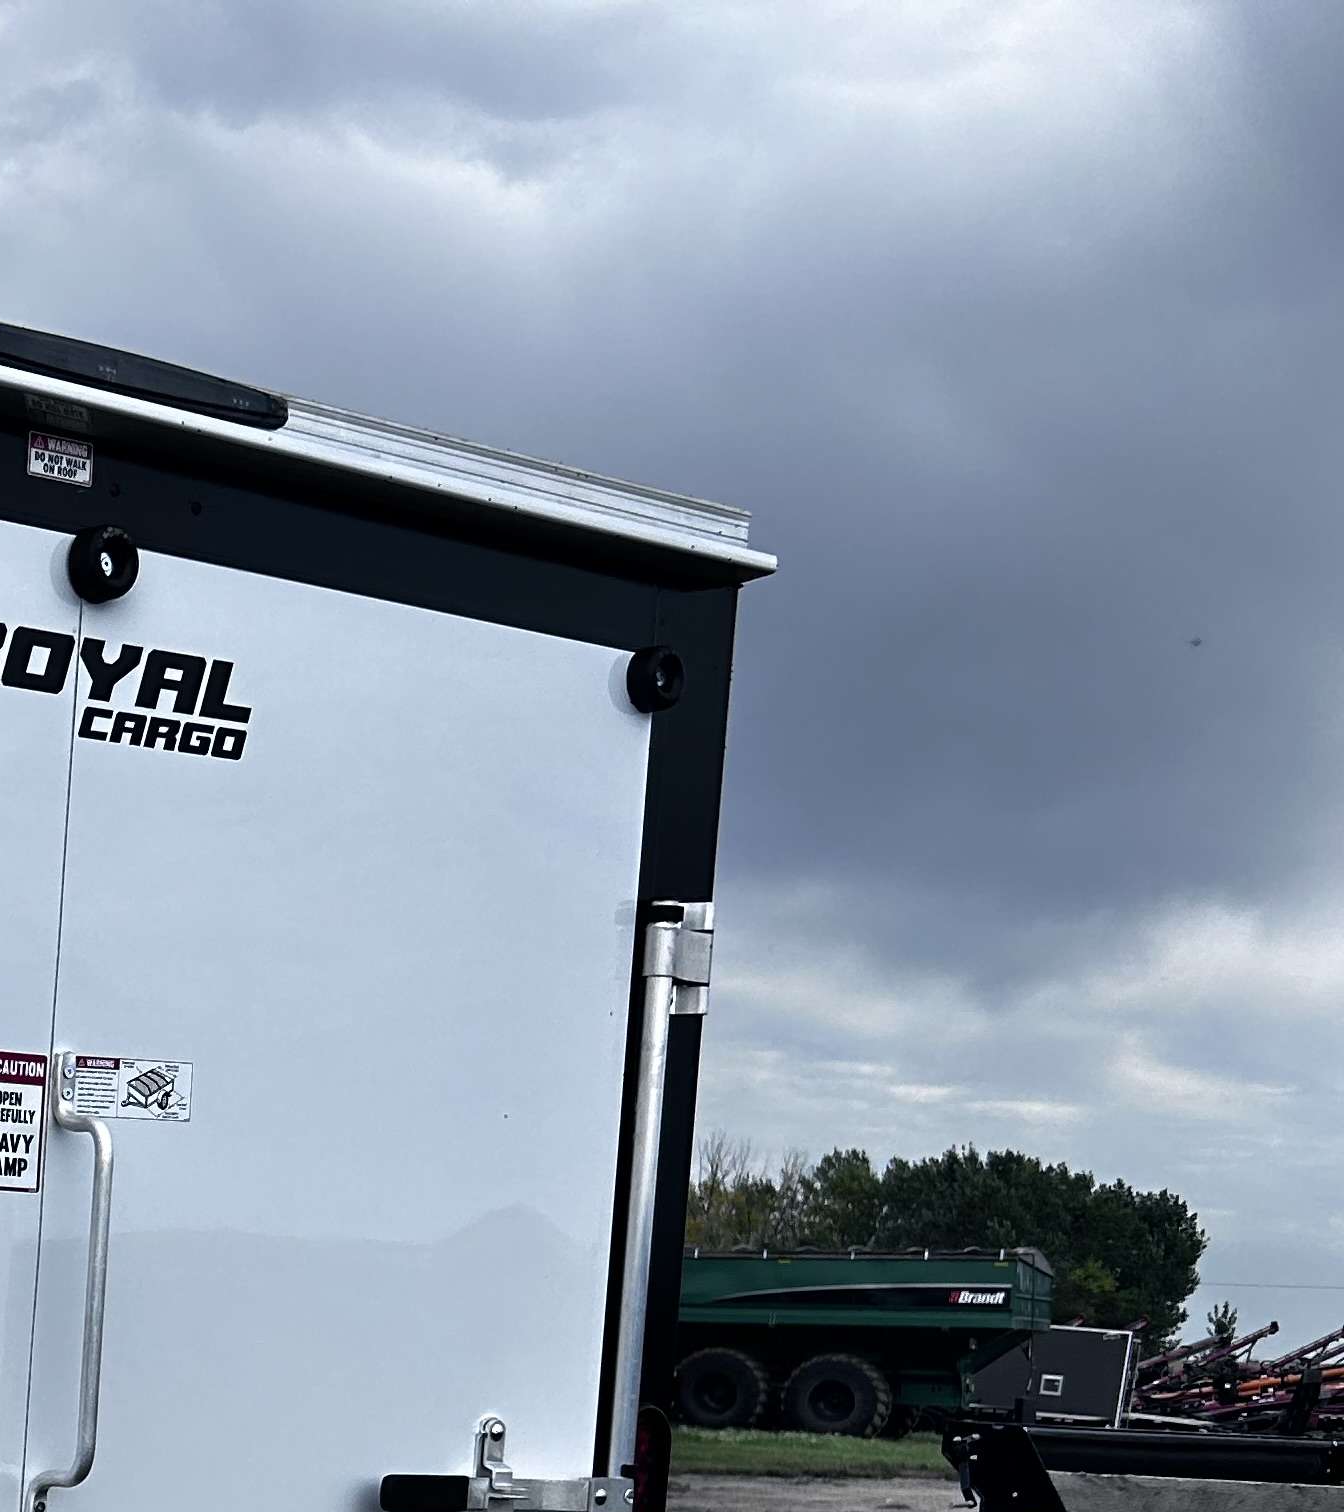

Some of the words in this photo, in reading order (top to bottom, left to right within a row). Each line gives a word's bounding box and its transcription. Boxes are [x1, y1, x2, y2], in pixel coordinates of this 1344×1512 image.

[34, 450, 46, 462] DO
[47, 453, 64, 466] NOT
[65, 456, 87, 471] WALK
[42, 462, 55, 475] ON
[57, 465, 78, 479] ROOF
[76, 705, 249, 762] CARGO
[958, 1290, 1005, 1304] Brandt
